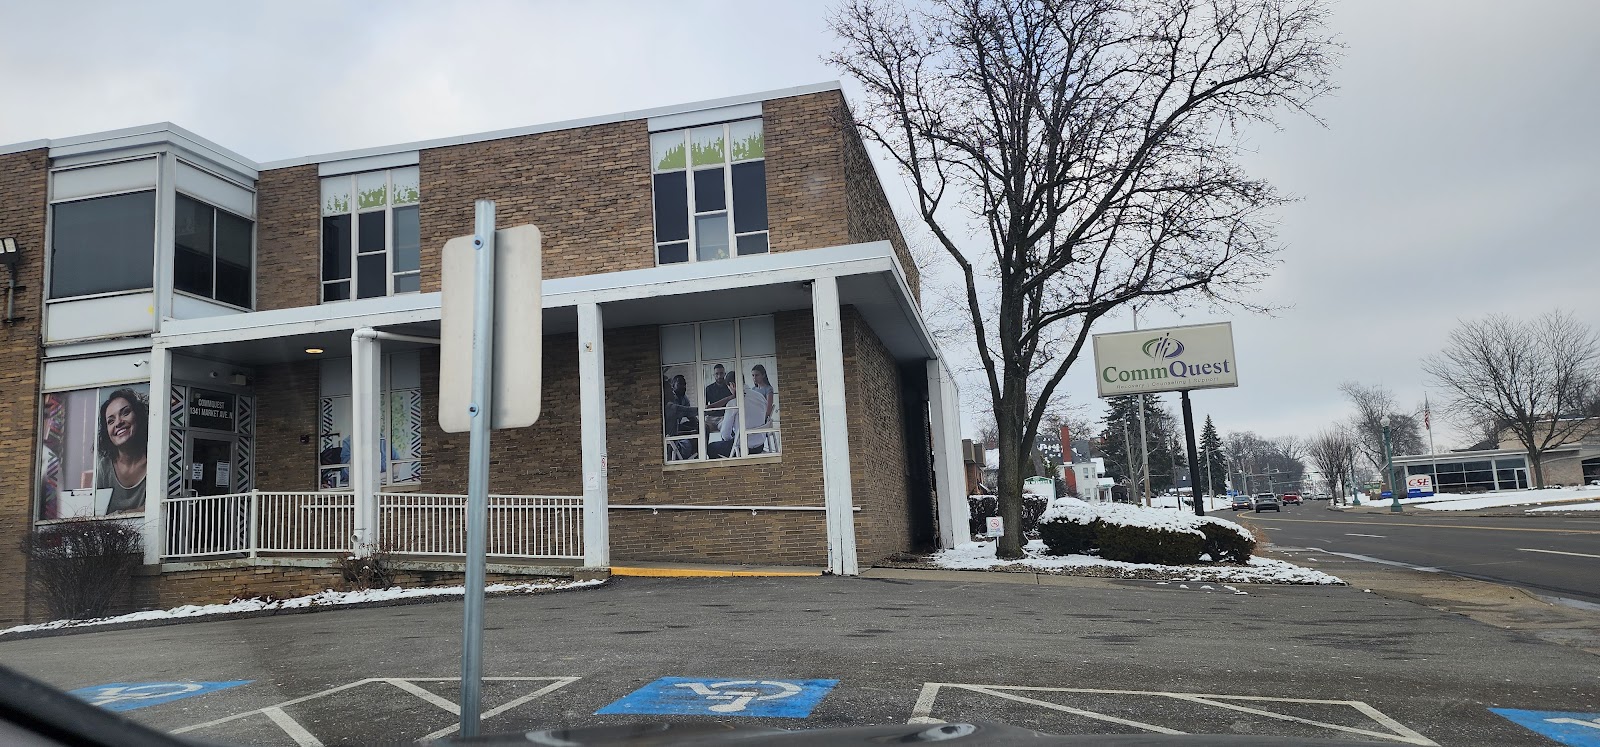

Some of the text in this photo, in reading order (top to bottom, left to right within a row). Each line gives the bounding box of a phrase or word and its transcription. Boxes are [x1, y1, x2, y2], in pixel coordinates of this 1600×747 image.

[1102, 359, 1230, 383] CommQuest
[1151, 379, 1187, 387] Counseling
[198, 399, 225, 409] COMMQUEST
[190, 407, 201, 416] 1341
[201, 408, 219, 418] MARKET
[1408, 478, 1429, 486] CSE
